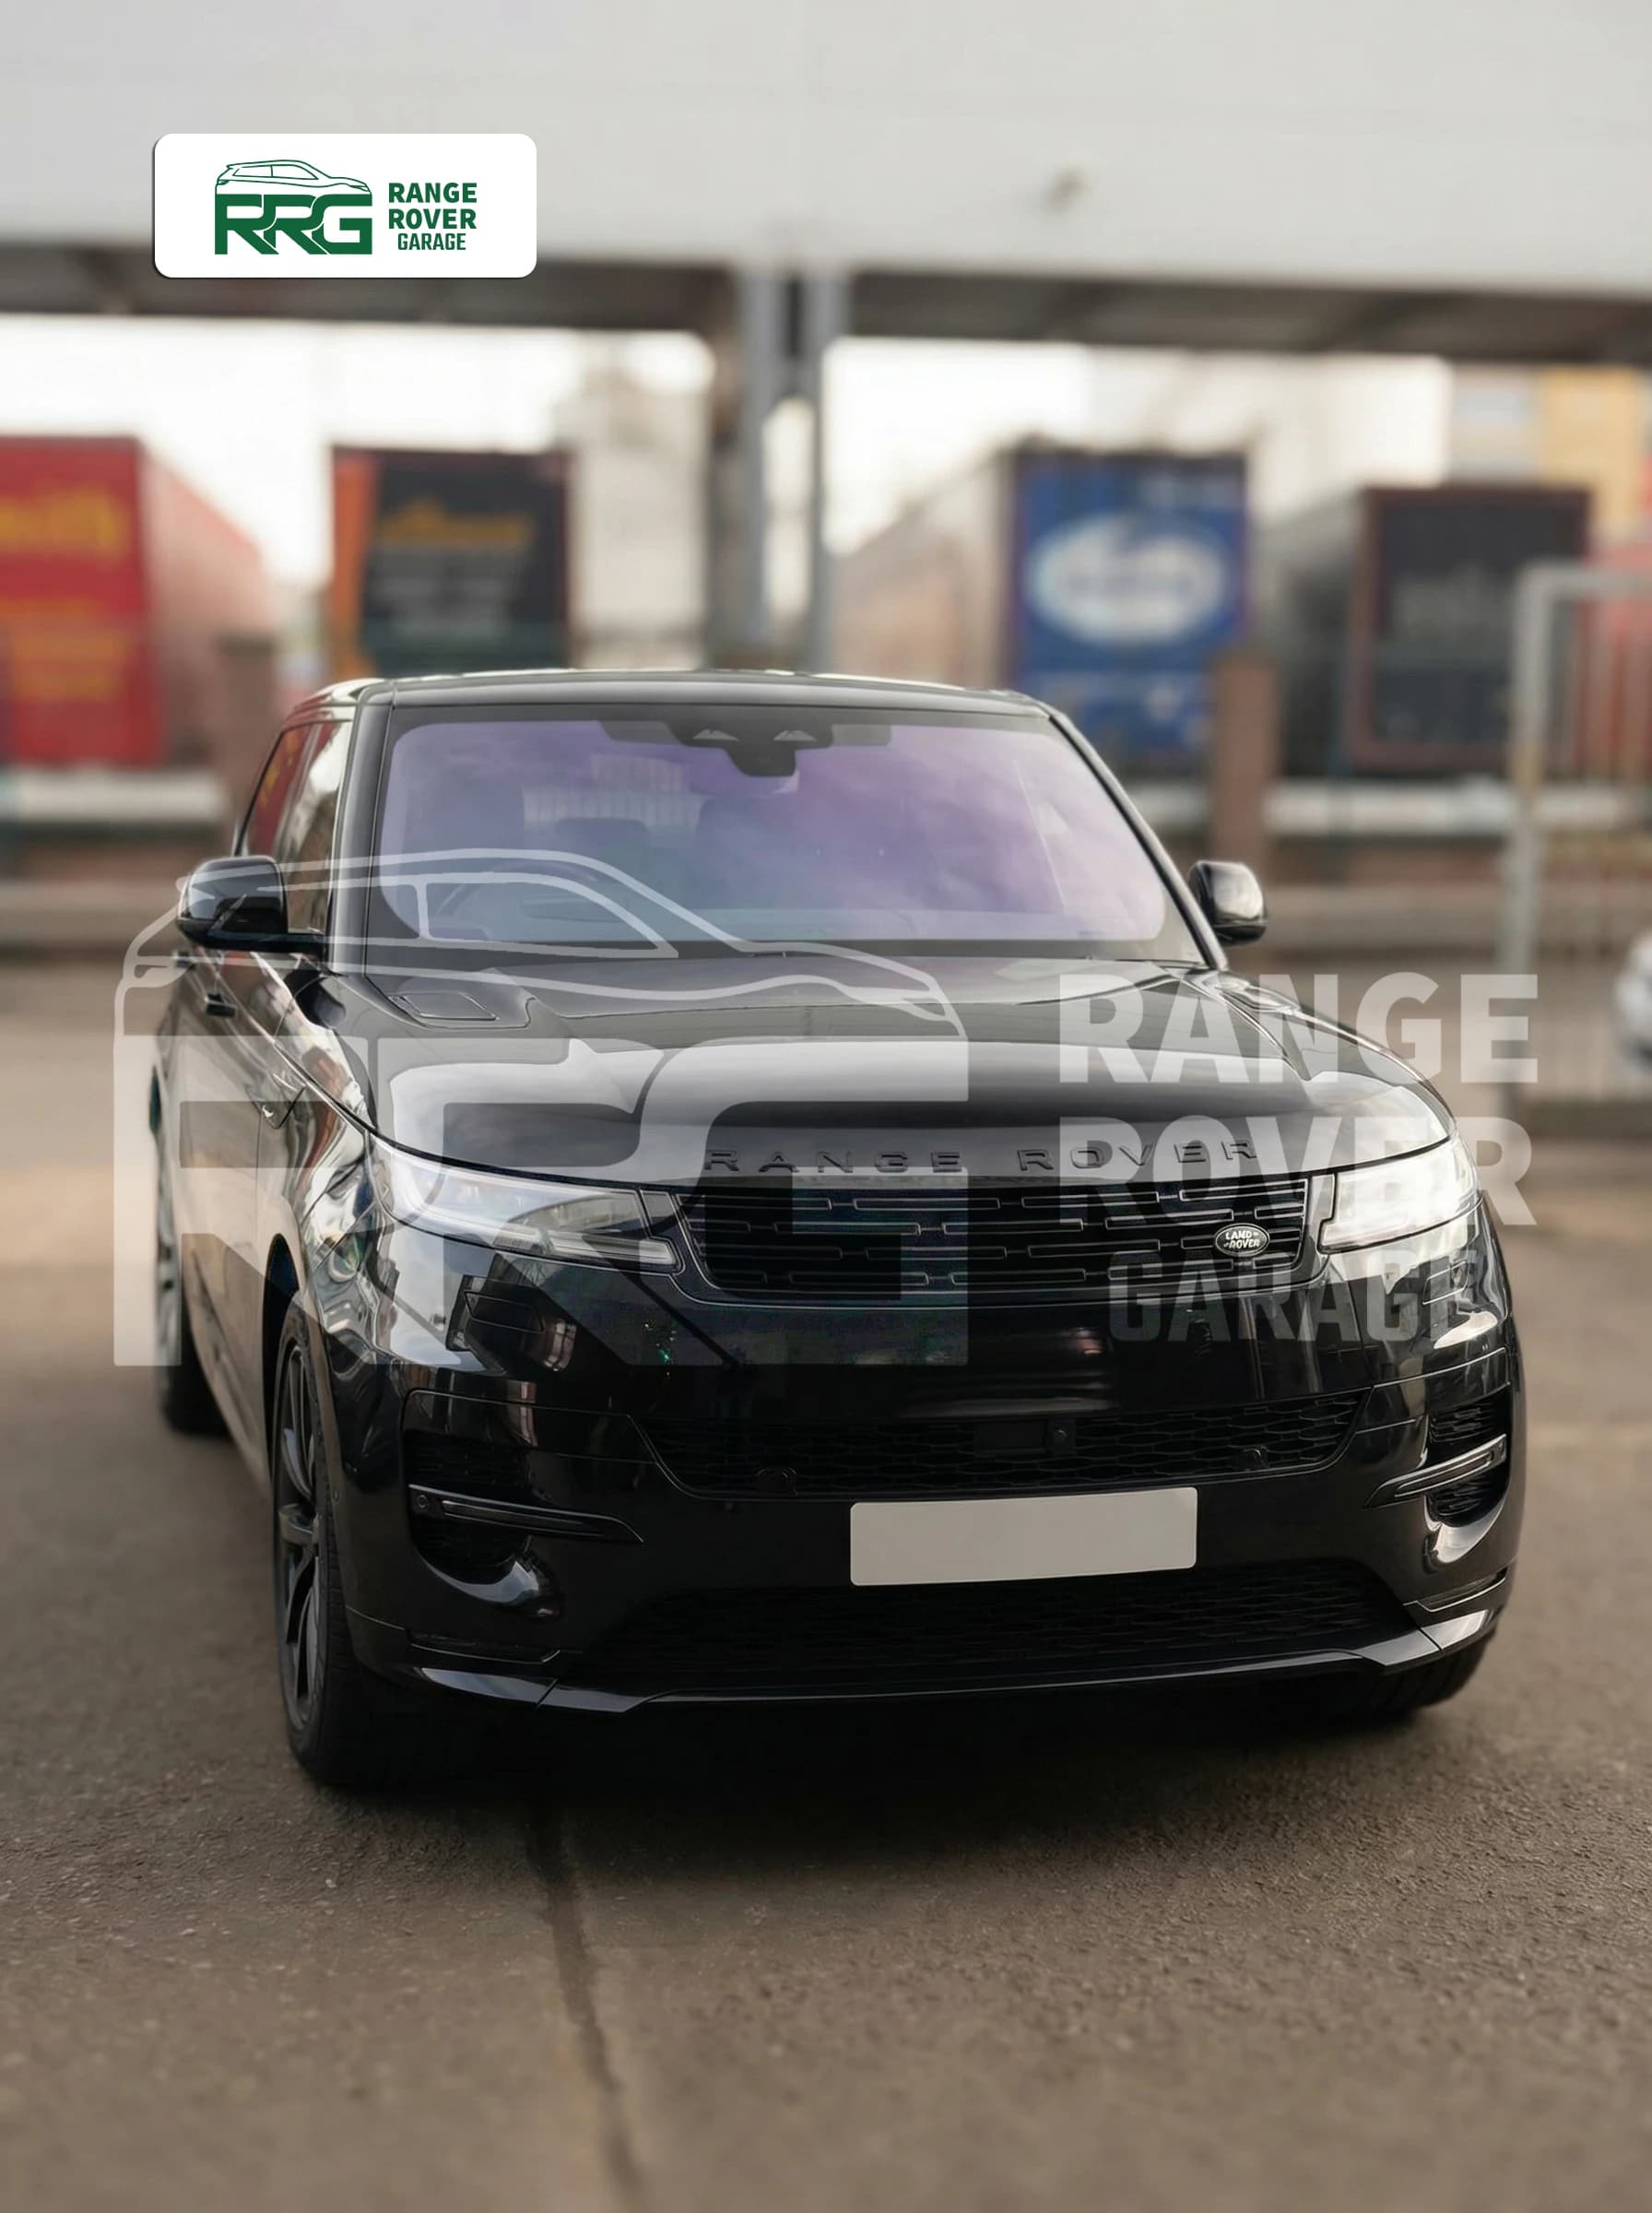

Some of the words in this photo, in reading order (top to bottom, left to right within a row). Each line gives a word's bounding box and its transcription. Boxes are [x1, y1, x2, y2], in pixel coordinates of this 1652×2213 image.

[703, 1149, 964, 1174] RANGE
[1018, 1139, 1257, 1173] ROVER
[1225, 1230, 1252, 1240] LAND
[1228, 1238, 1260, 1249] ROVER
